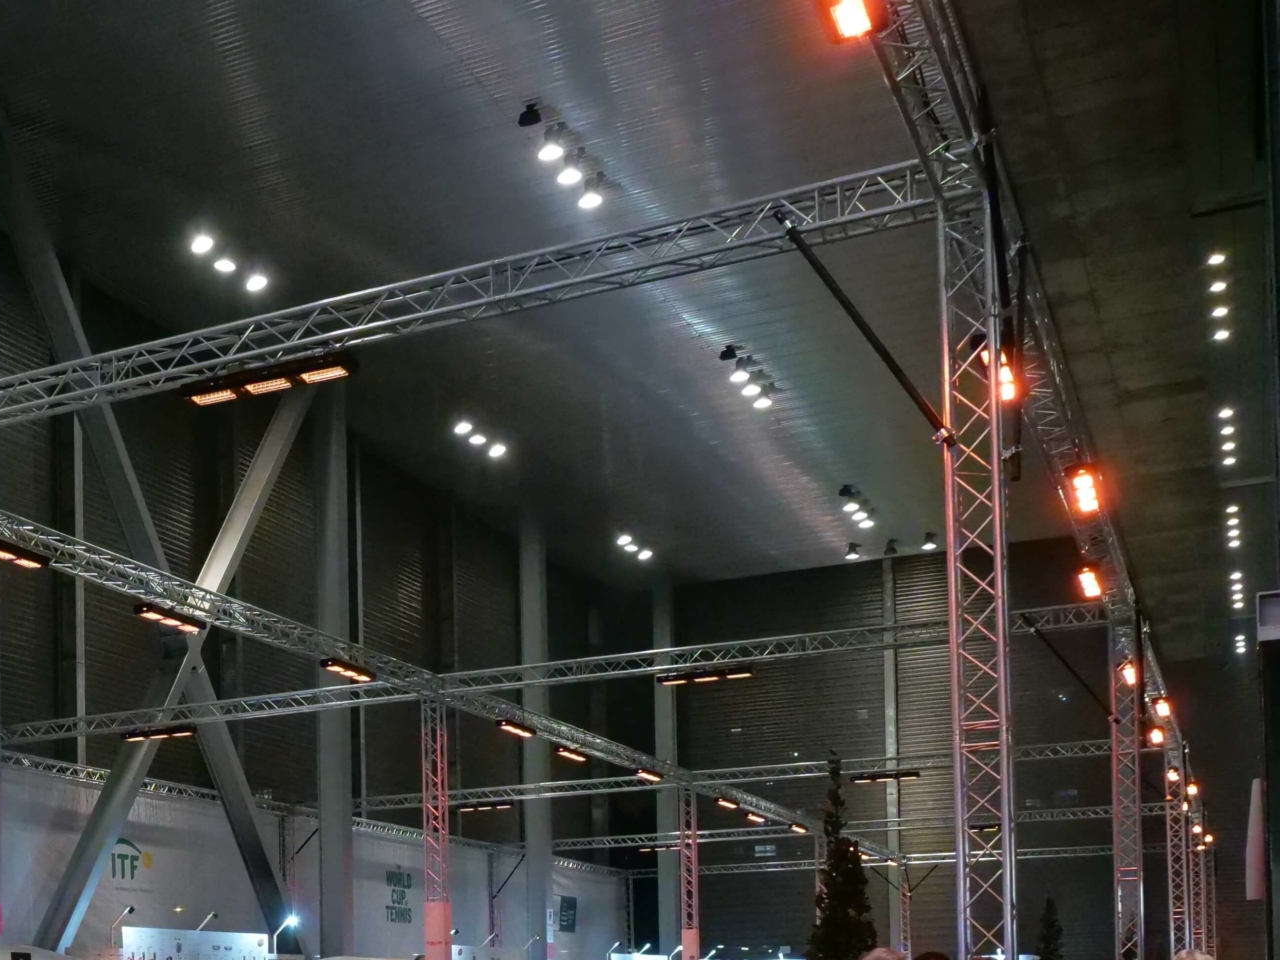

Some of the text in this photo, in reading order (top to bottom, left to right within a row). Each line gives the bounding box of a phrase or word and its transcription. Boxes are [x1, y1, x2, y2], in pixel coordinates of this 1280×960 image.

[111, 853, 140, 880] ITF
[385, 870, 412, 889] WORLD
[391, 888, 406, 905] CUP
[385, 905, 413, 924] TENNIS
